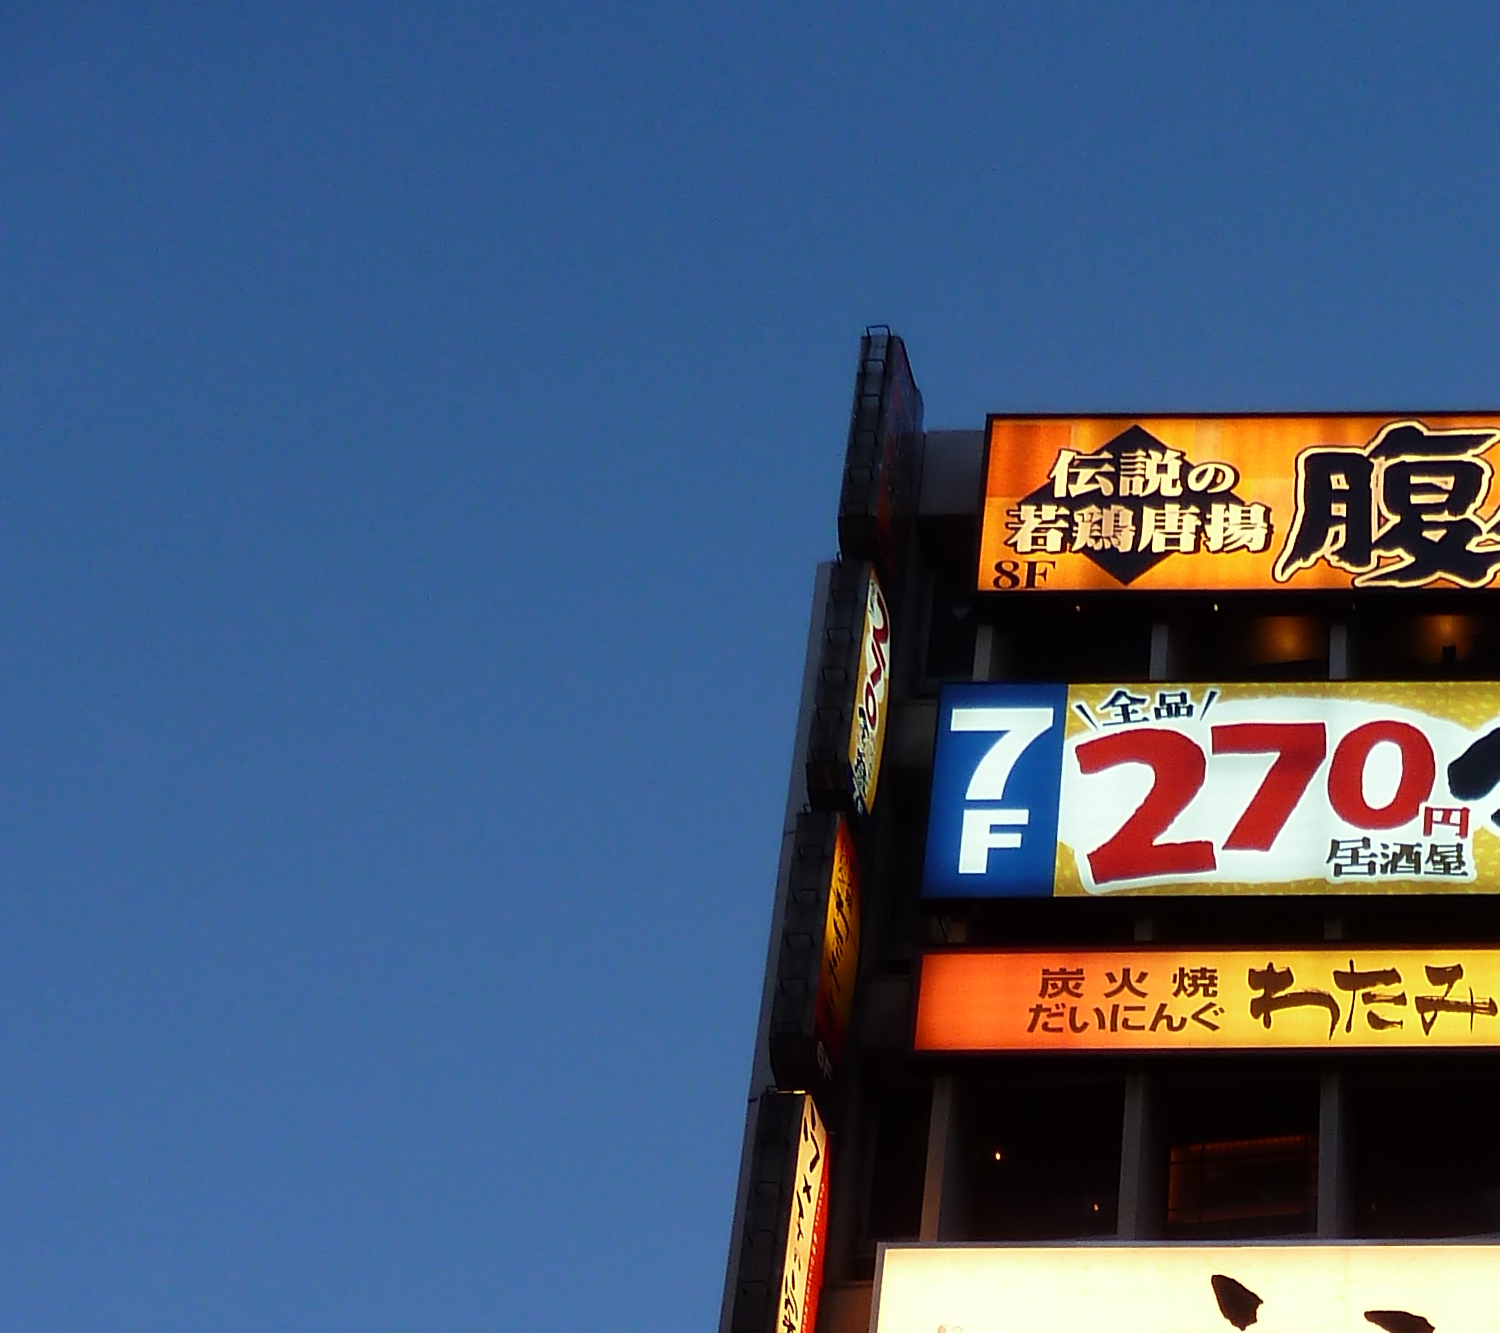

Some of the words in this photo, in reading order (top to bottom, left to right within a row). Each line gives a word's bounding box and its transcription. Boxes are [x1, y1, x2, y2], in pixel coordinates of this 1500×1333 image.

[1047, 446, 1238, 500] 伝説の
[1005, 500, 1272, 556] 若鶏唐揚
[991, 559, 1056, 590] 8F
[1106, 690, 1198, 727] 全品
[1323, 835, 1473, 879] 居酒屋
[1038, 964, 1221, 999] 炭火焼
[1027, 1000, 1227, 1035] だいにんぐ
